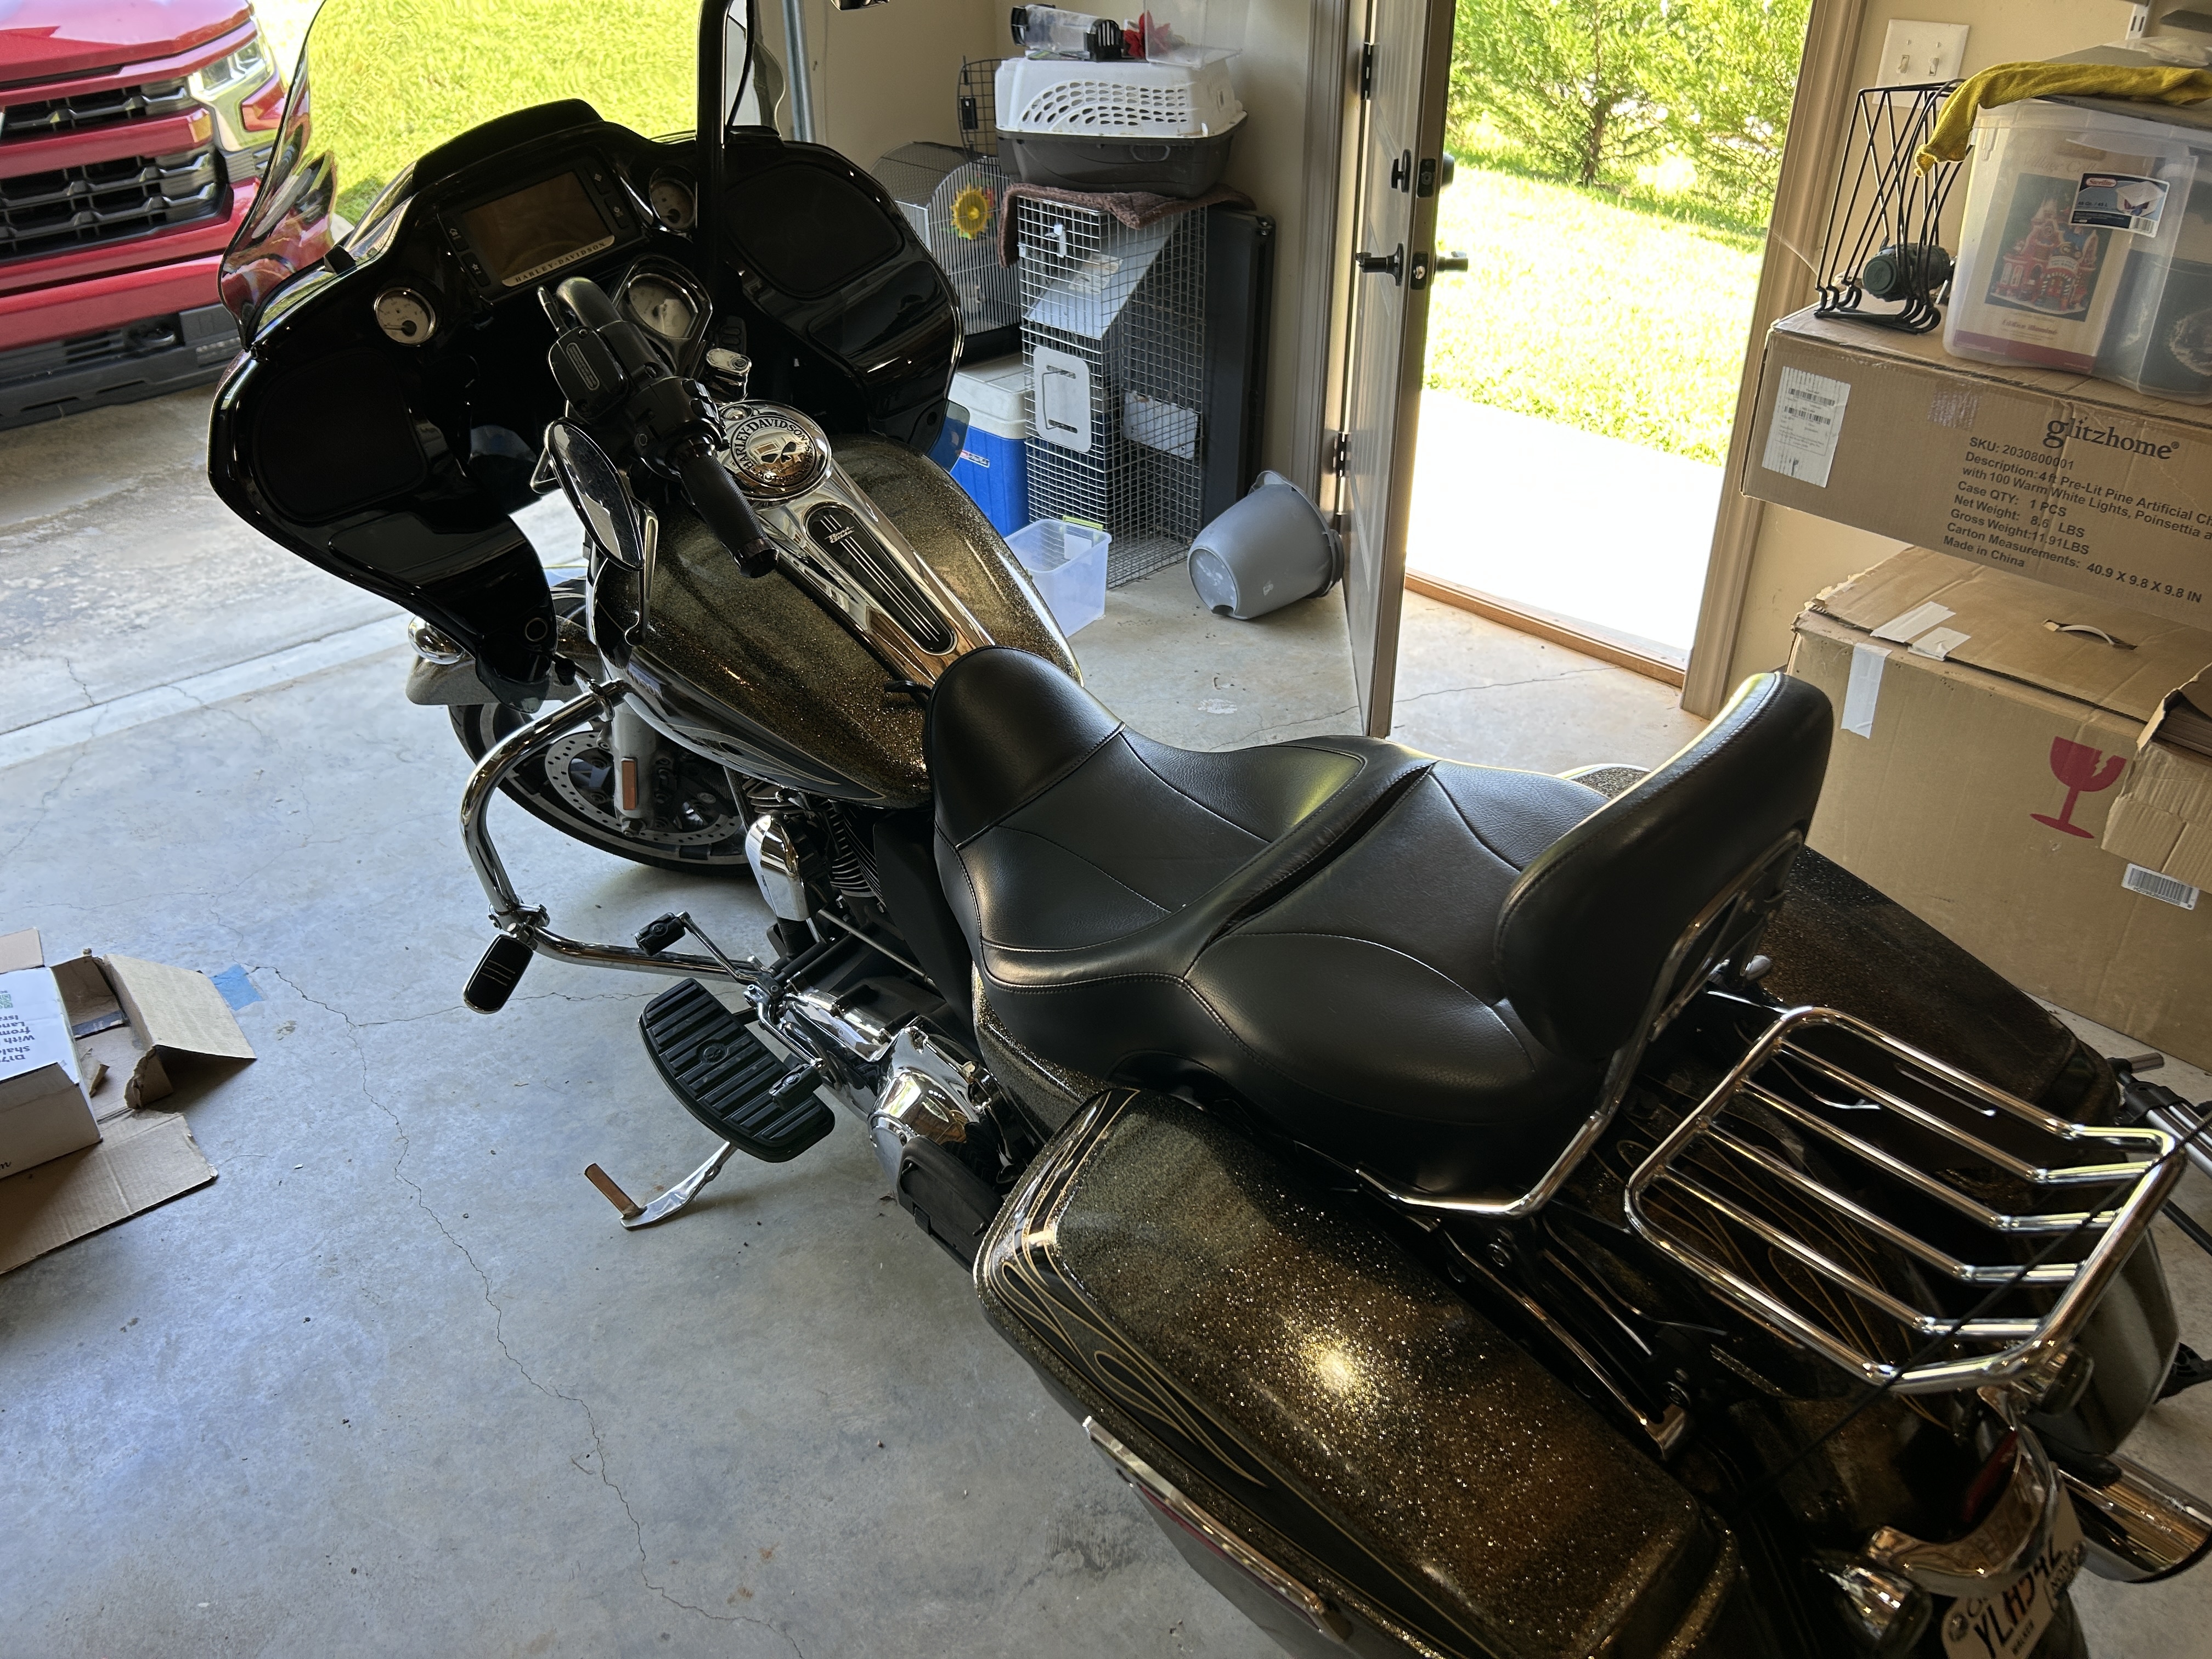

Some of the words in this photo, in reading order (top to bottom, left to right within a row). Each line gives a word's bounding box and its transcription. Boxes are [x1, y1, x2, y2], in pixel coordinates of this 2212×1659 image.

[515, 241, 606, 283] HARLEY-DAVIDSON
[735, 418, 809, 470] HARLEY-DAVIDSON
[1969, 437, 2000, 453] SKU:
[2002, 444, 2074, 470] 2030800001
[1950, 508, 1985, 526] Gross
[1954, 494, 1973, 508] Net
[1976, 500, 2021, 521] Weight:
[2030, 515, 2050, 528] 8.6
[2058, 522, 2085, 538] LBS
[1957, 481, 1987, 496] Case
[1990, 489, 2019, 505] QTY:
[2030, 499, 2036, 509] 1
[2039, 501, 2067, 517] PCS
[1962, 467, 1987, 480] with
[1989, 472, 2010, 484] 100
[2013, 477, 2048, 494] Warm
[2051, 487, 2086, 504] White
[2089, 497, 2131, 519] Lights,
[2135, 509, 2200, 537] Poinsettia
[2060, 476, 2103, 496] Pre-Lit
[2105, 488, 2134, 504] Pine
[2136, 498, 2193, 521] Artificial
[1943, 535, 1974, 552] Made
[1976, 545, 1988, 556] in
[1990, 550, 2025, 567] China
[1947, 522, 1985, 541] Carton
[1988, 534, 2081, 568] Measurements:
[2086, 562, 2113, 578] 40.9
[2116, 571, 2126, 583] X
[2129, 575, 2149, 589] 9.8
[2151, 580, 2162, 593] X
[2164, 585, 2185, 599] 9.8
[2187, 590, 2203, 603] IN
